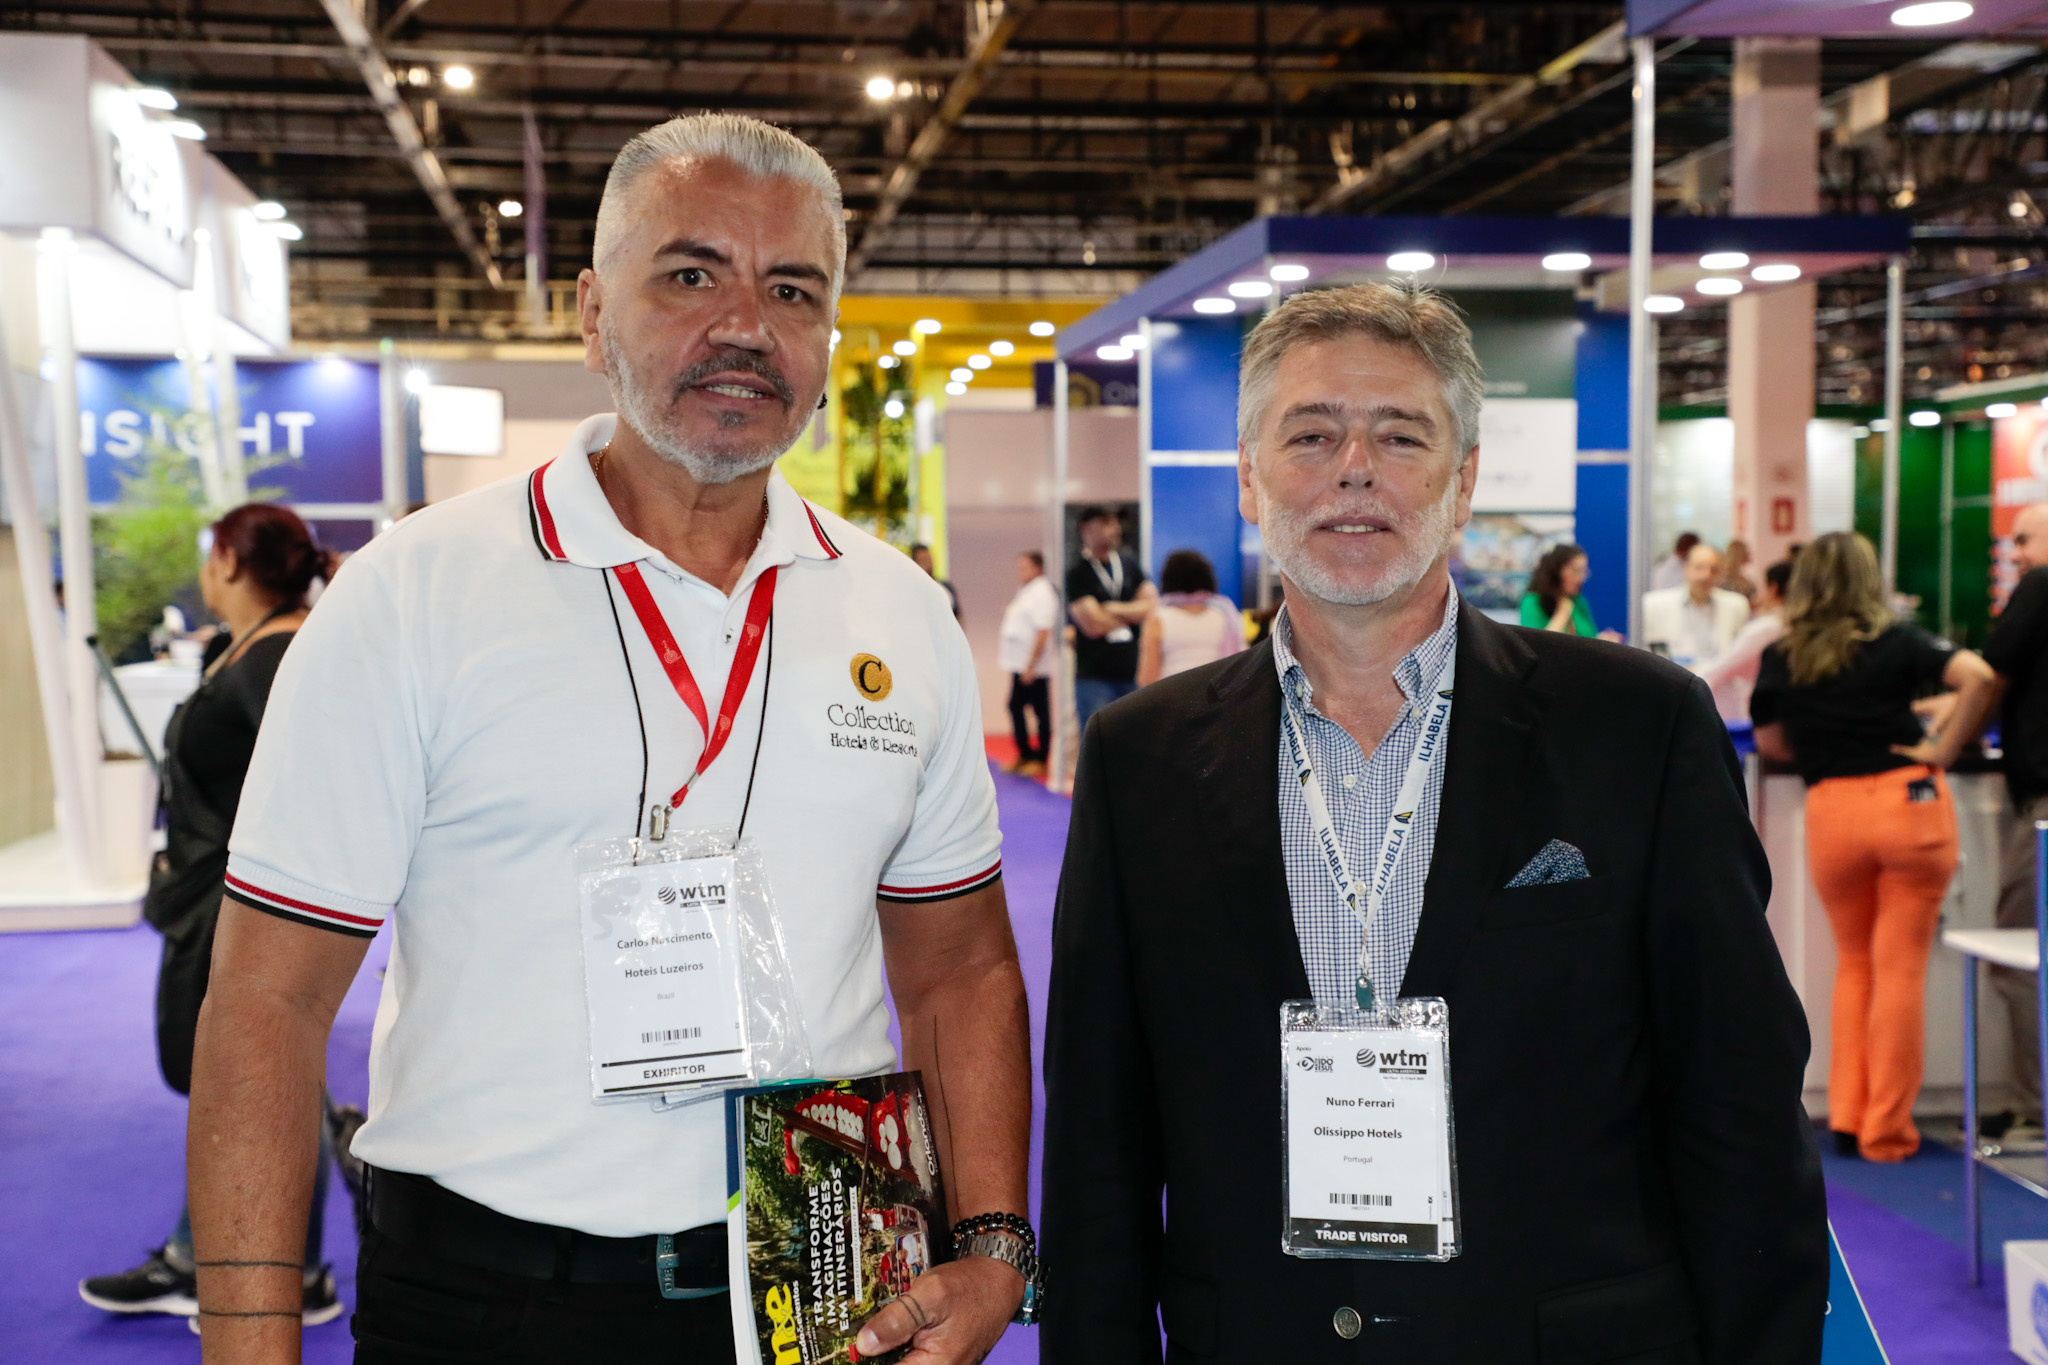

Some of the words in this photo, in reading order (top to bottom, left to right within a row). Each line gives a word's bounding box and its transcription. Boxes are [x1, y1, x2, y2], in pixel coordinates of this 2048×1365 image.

[858, 660, 882, 693] C
[827, 703, 916, 736] Collection
[1418, 704, 1449, 762] ILHABELA
[830, 732, 868, 750] Hotels
[870, 736, 880, 751] &
[882, 738, 918, 757] Resorts
[1283, 712, 1304, 769] ILHABELA
[1319, 827, 1348, 891] ILHABELA
[1375, 828, 1405, 895] ILHABELA
[680, 882, 726, 900] wtm
[616, 938, 649, 949] Carlos
[651, 931, 713, 945] Nascimento
[625, 966, 658, 978] Hoteis
[660, 962, 704, 975] Luzeiros
[657, 992, 675, 1000] Brazil
[643, 1064, 706, 1079] EXHIBITOR
[1379, 1049, 1427, 1066] wtm
[1326, 1097, 1356, 1107] Nuno
[1358, 1098, 1395, 1108] Ferrari
[917, 1105, 935, 1176] Orlando
[1314, 1126, 1364, 1139] Olissippo
[1367, 1128, 1403, 1139] Hotels
[1343, 1155, 1373, 1165] Portugal
[832, 1167, 848, 1296] ITINERÁRIOS
[1315, 1230, 1356, 1241] TRADE
[1359, 1231, 1408, 1244] VISITOR
[809, 1185, 824, 1326] TRANSFORME
[820, 1180, 836, 1324] IMAGINAÇÕES
[838, 1300, 849, 1331] EM
